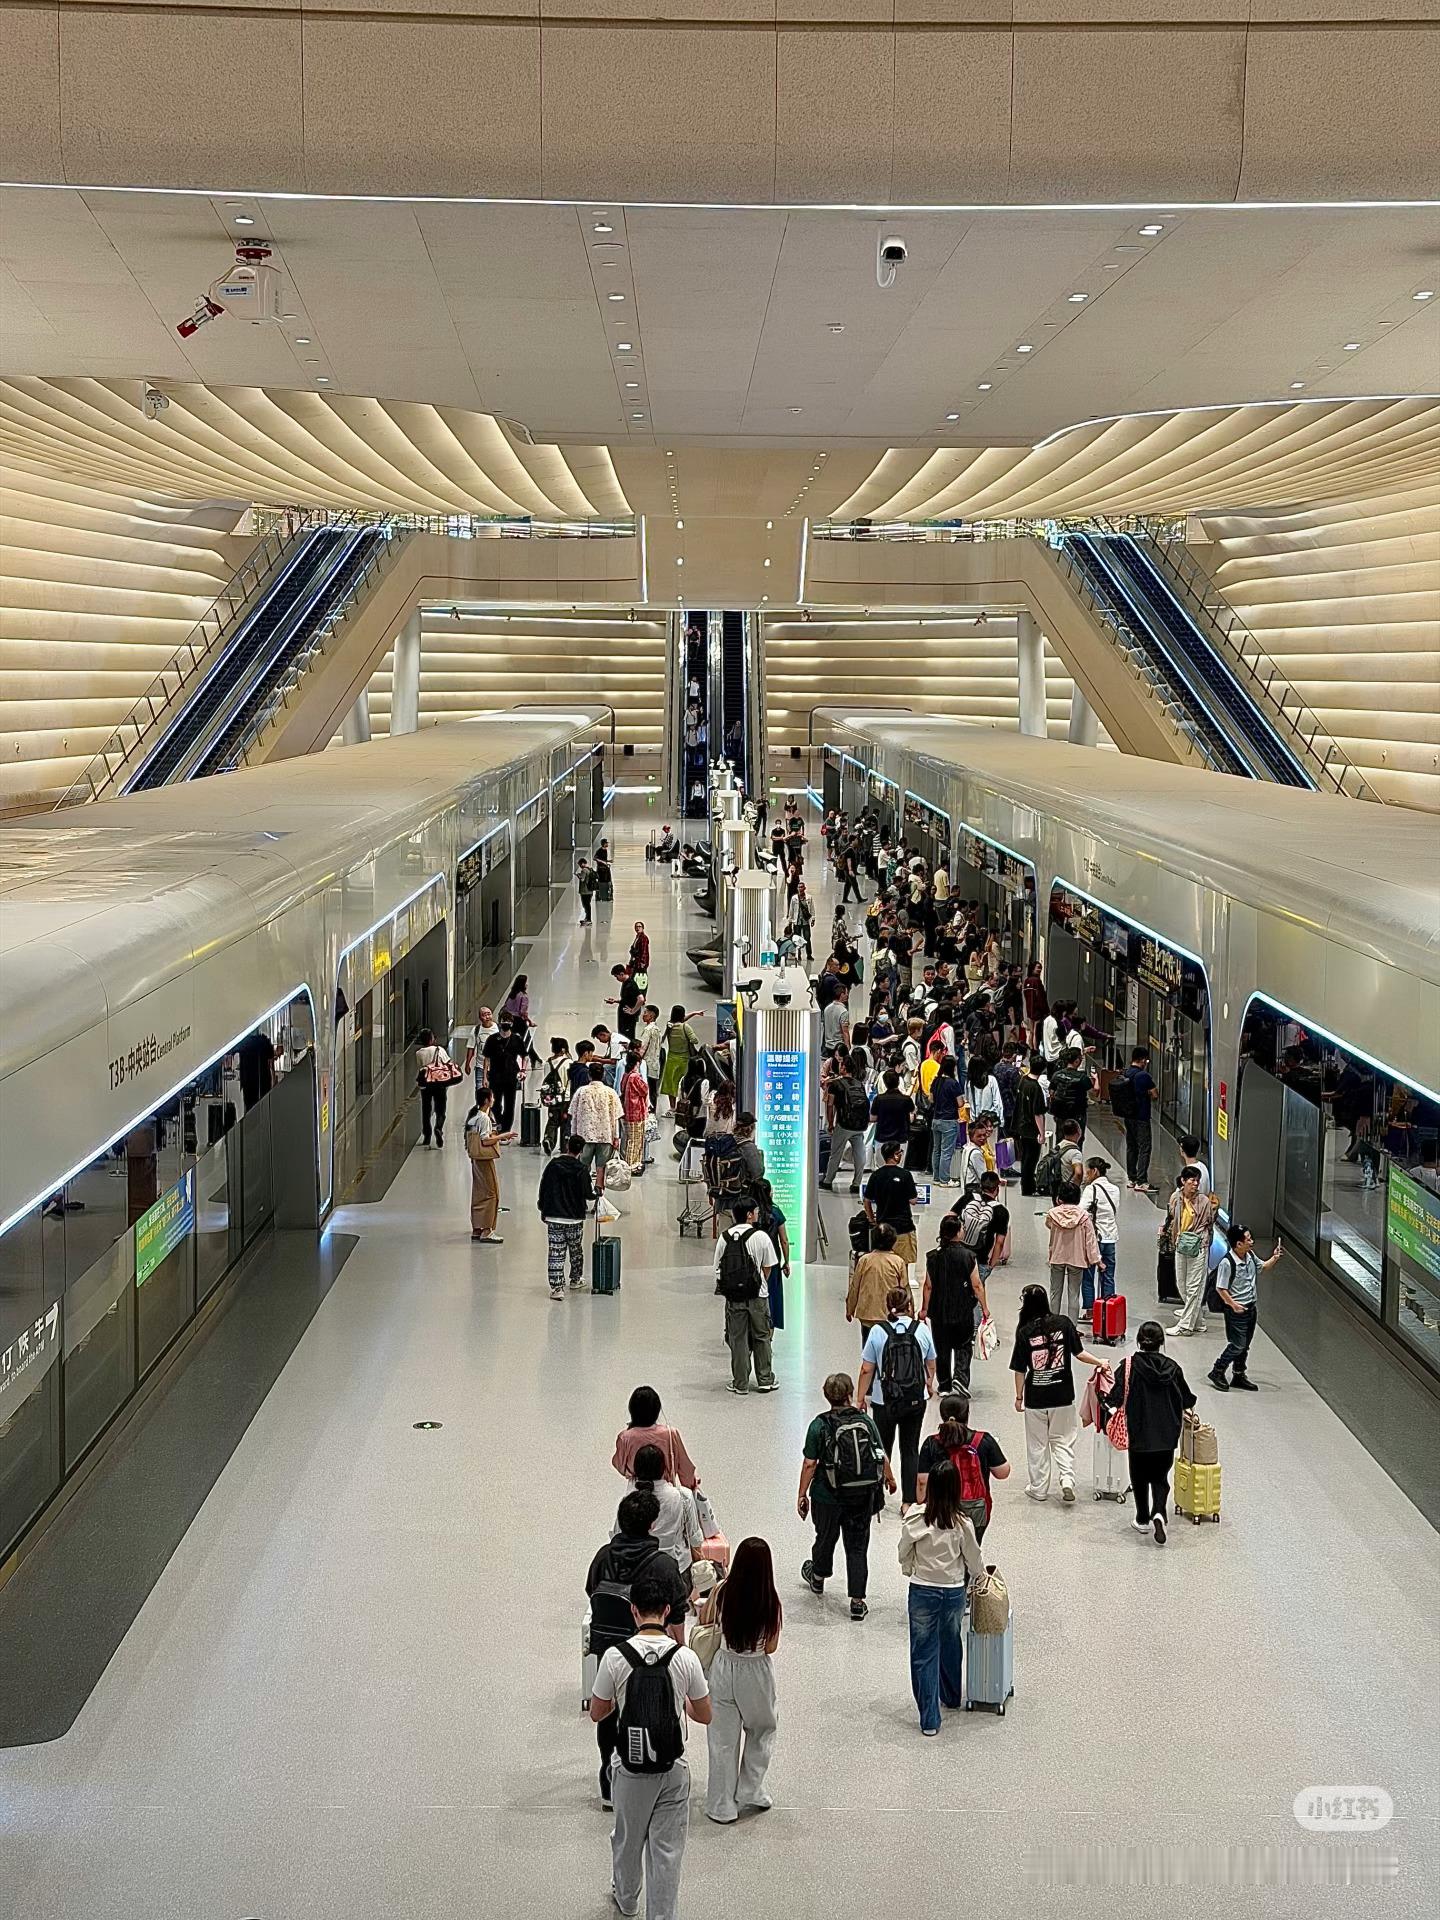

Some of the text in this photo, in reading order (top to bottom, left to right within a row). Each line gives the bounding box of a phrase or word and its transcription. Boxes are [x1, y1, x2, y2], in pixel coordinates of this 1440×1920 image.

[108, 1024, 191, 1091] T3B-中央站台 Central Platform
[630, 1729, 642, 1763] PUMA
